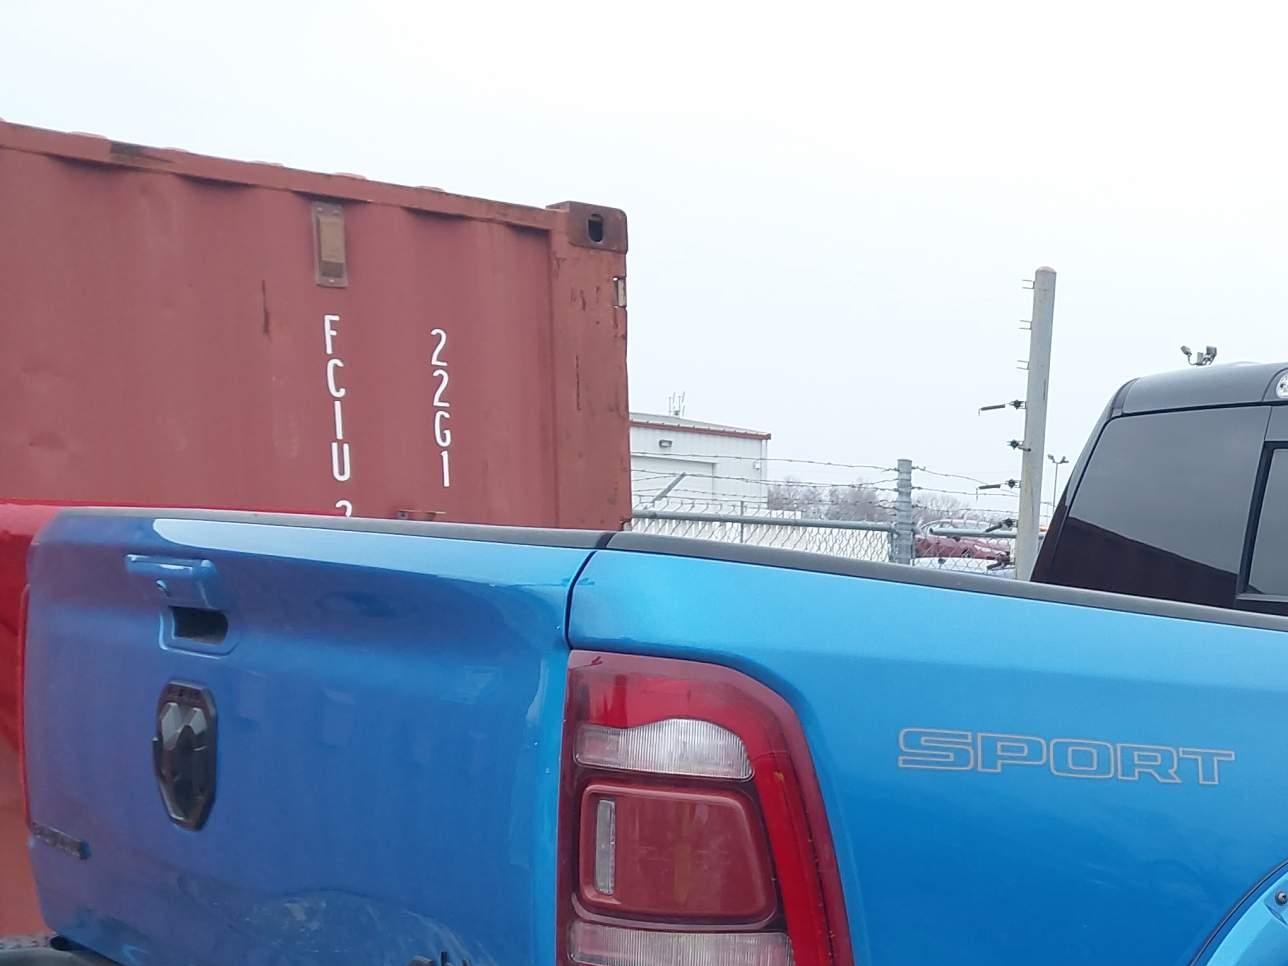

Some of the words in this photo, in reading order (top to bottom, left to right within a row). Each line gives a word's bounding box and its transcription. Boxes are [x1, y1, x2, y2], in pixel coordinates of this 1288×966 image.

[324, 314, 351, 482] FCIU
[430, 328, 452, 488] 22G1
[898, 727, 1236, 786] SPORT
